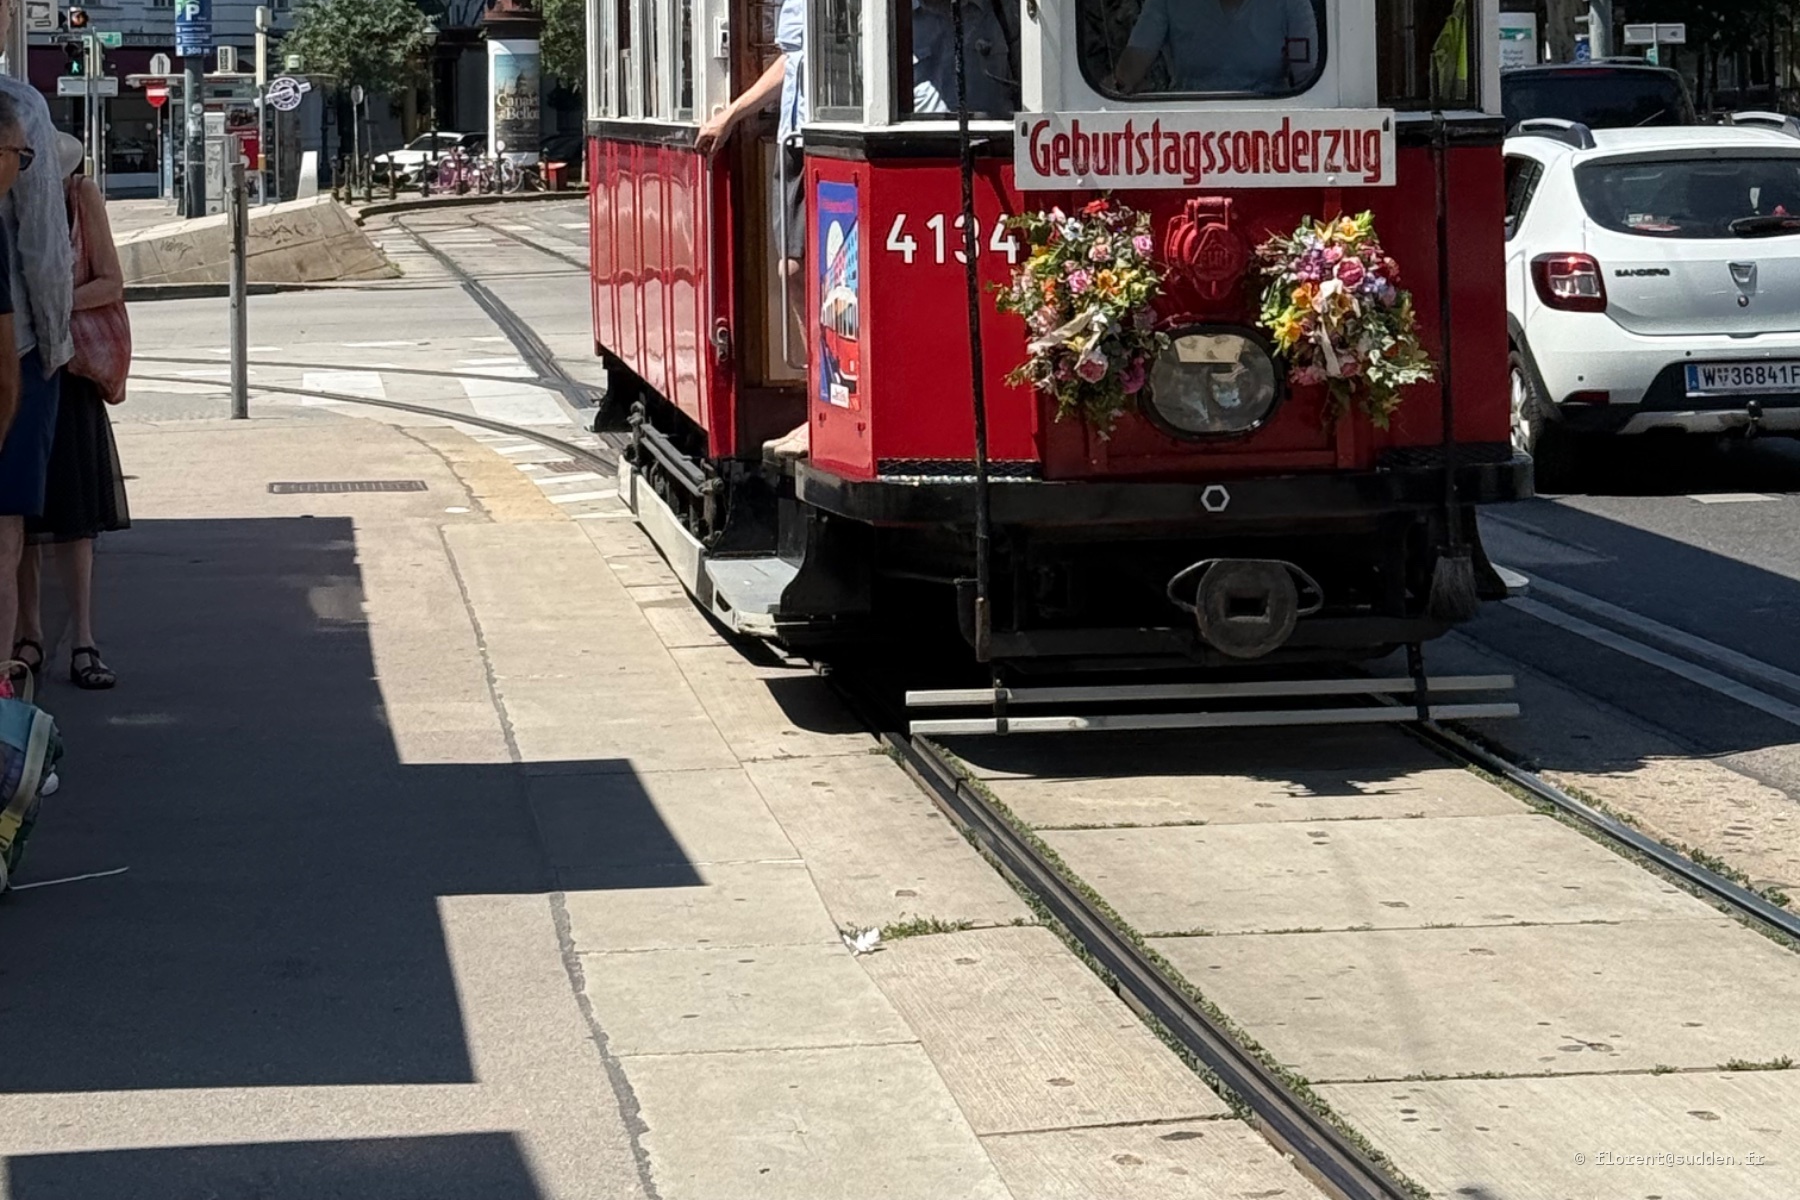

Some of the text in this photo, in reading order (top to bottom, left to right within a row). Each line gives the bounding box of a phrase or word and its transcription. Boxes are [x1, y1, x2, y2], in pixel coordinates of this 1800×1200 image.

[186, 4, 200, 21] P
[1029, 116, 1381, 185] Geburtstagssonderzug
[886, 213, 1020, 264] 4134
[1614, 268, 1670, 277] SANDERO
